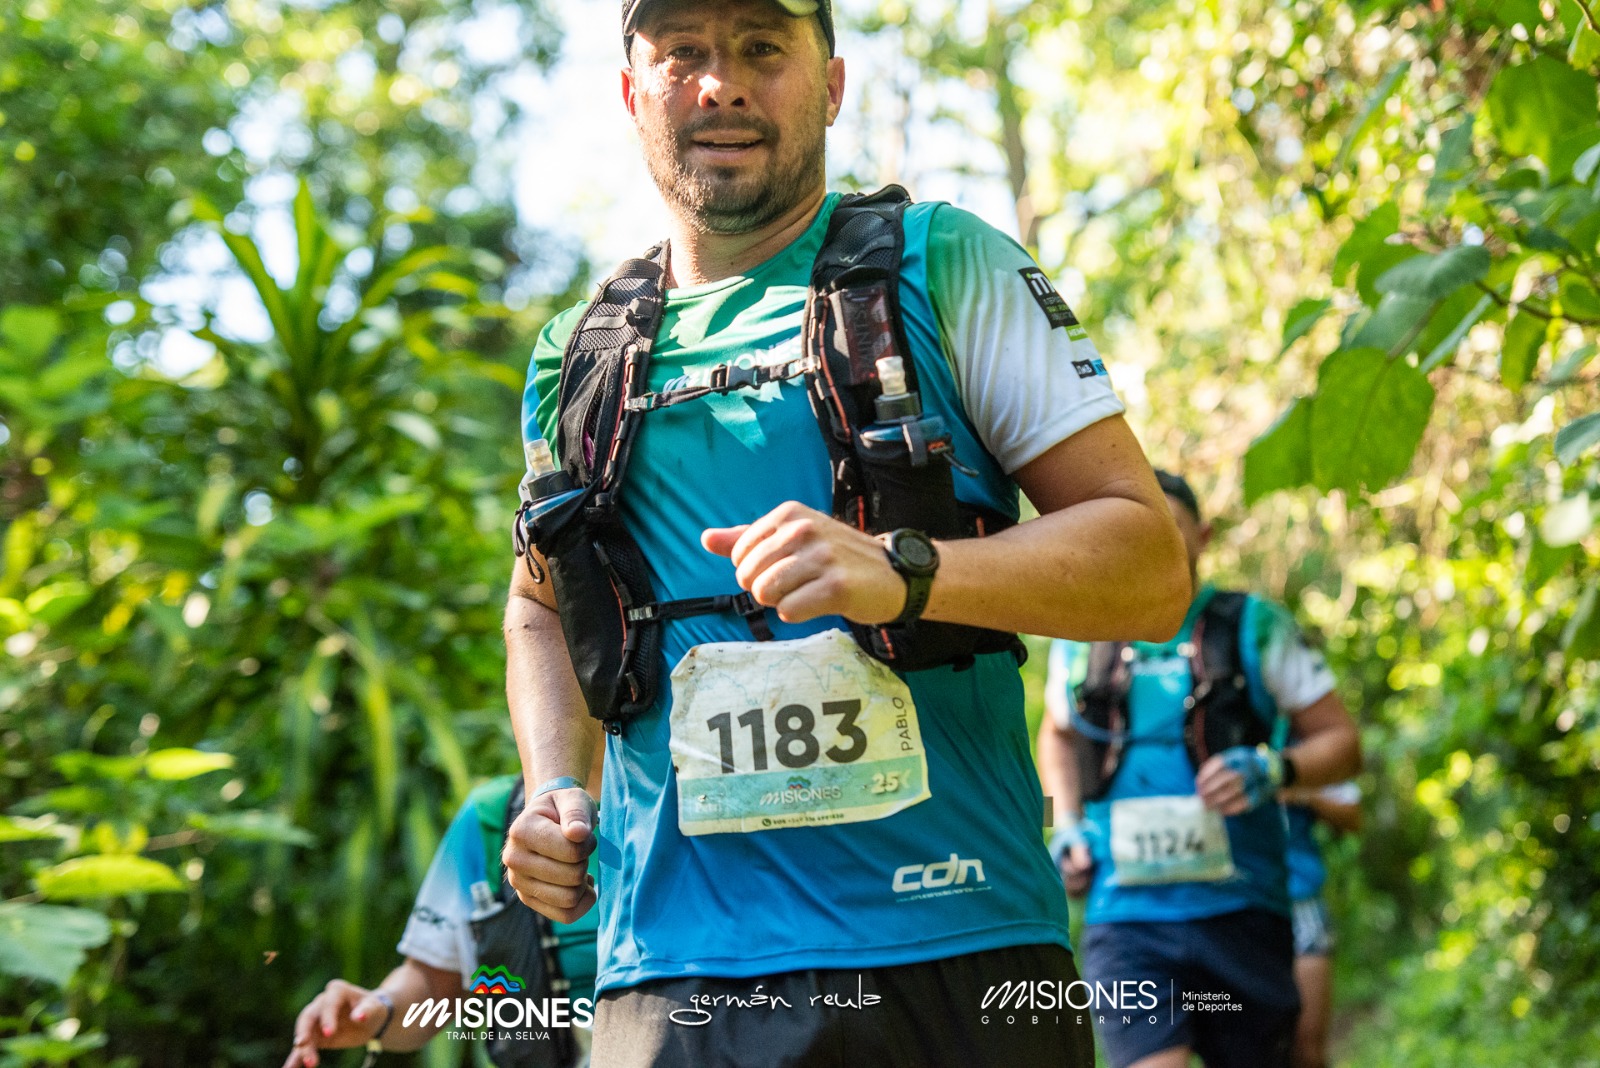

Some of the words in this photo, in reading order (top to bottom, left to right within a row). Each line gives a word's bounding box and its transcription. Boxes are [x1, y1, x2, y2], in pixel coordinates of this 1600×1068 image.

[707, 698, 868, 774] 1183
[892, 696, 914, 752] PABLO
[759, 785, 842, 806] MISIONES
[892, 853, 986, 893] cdn
